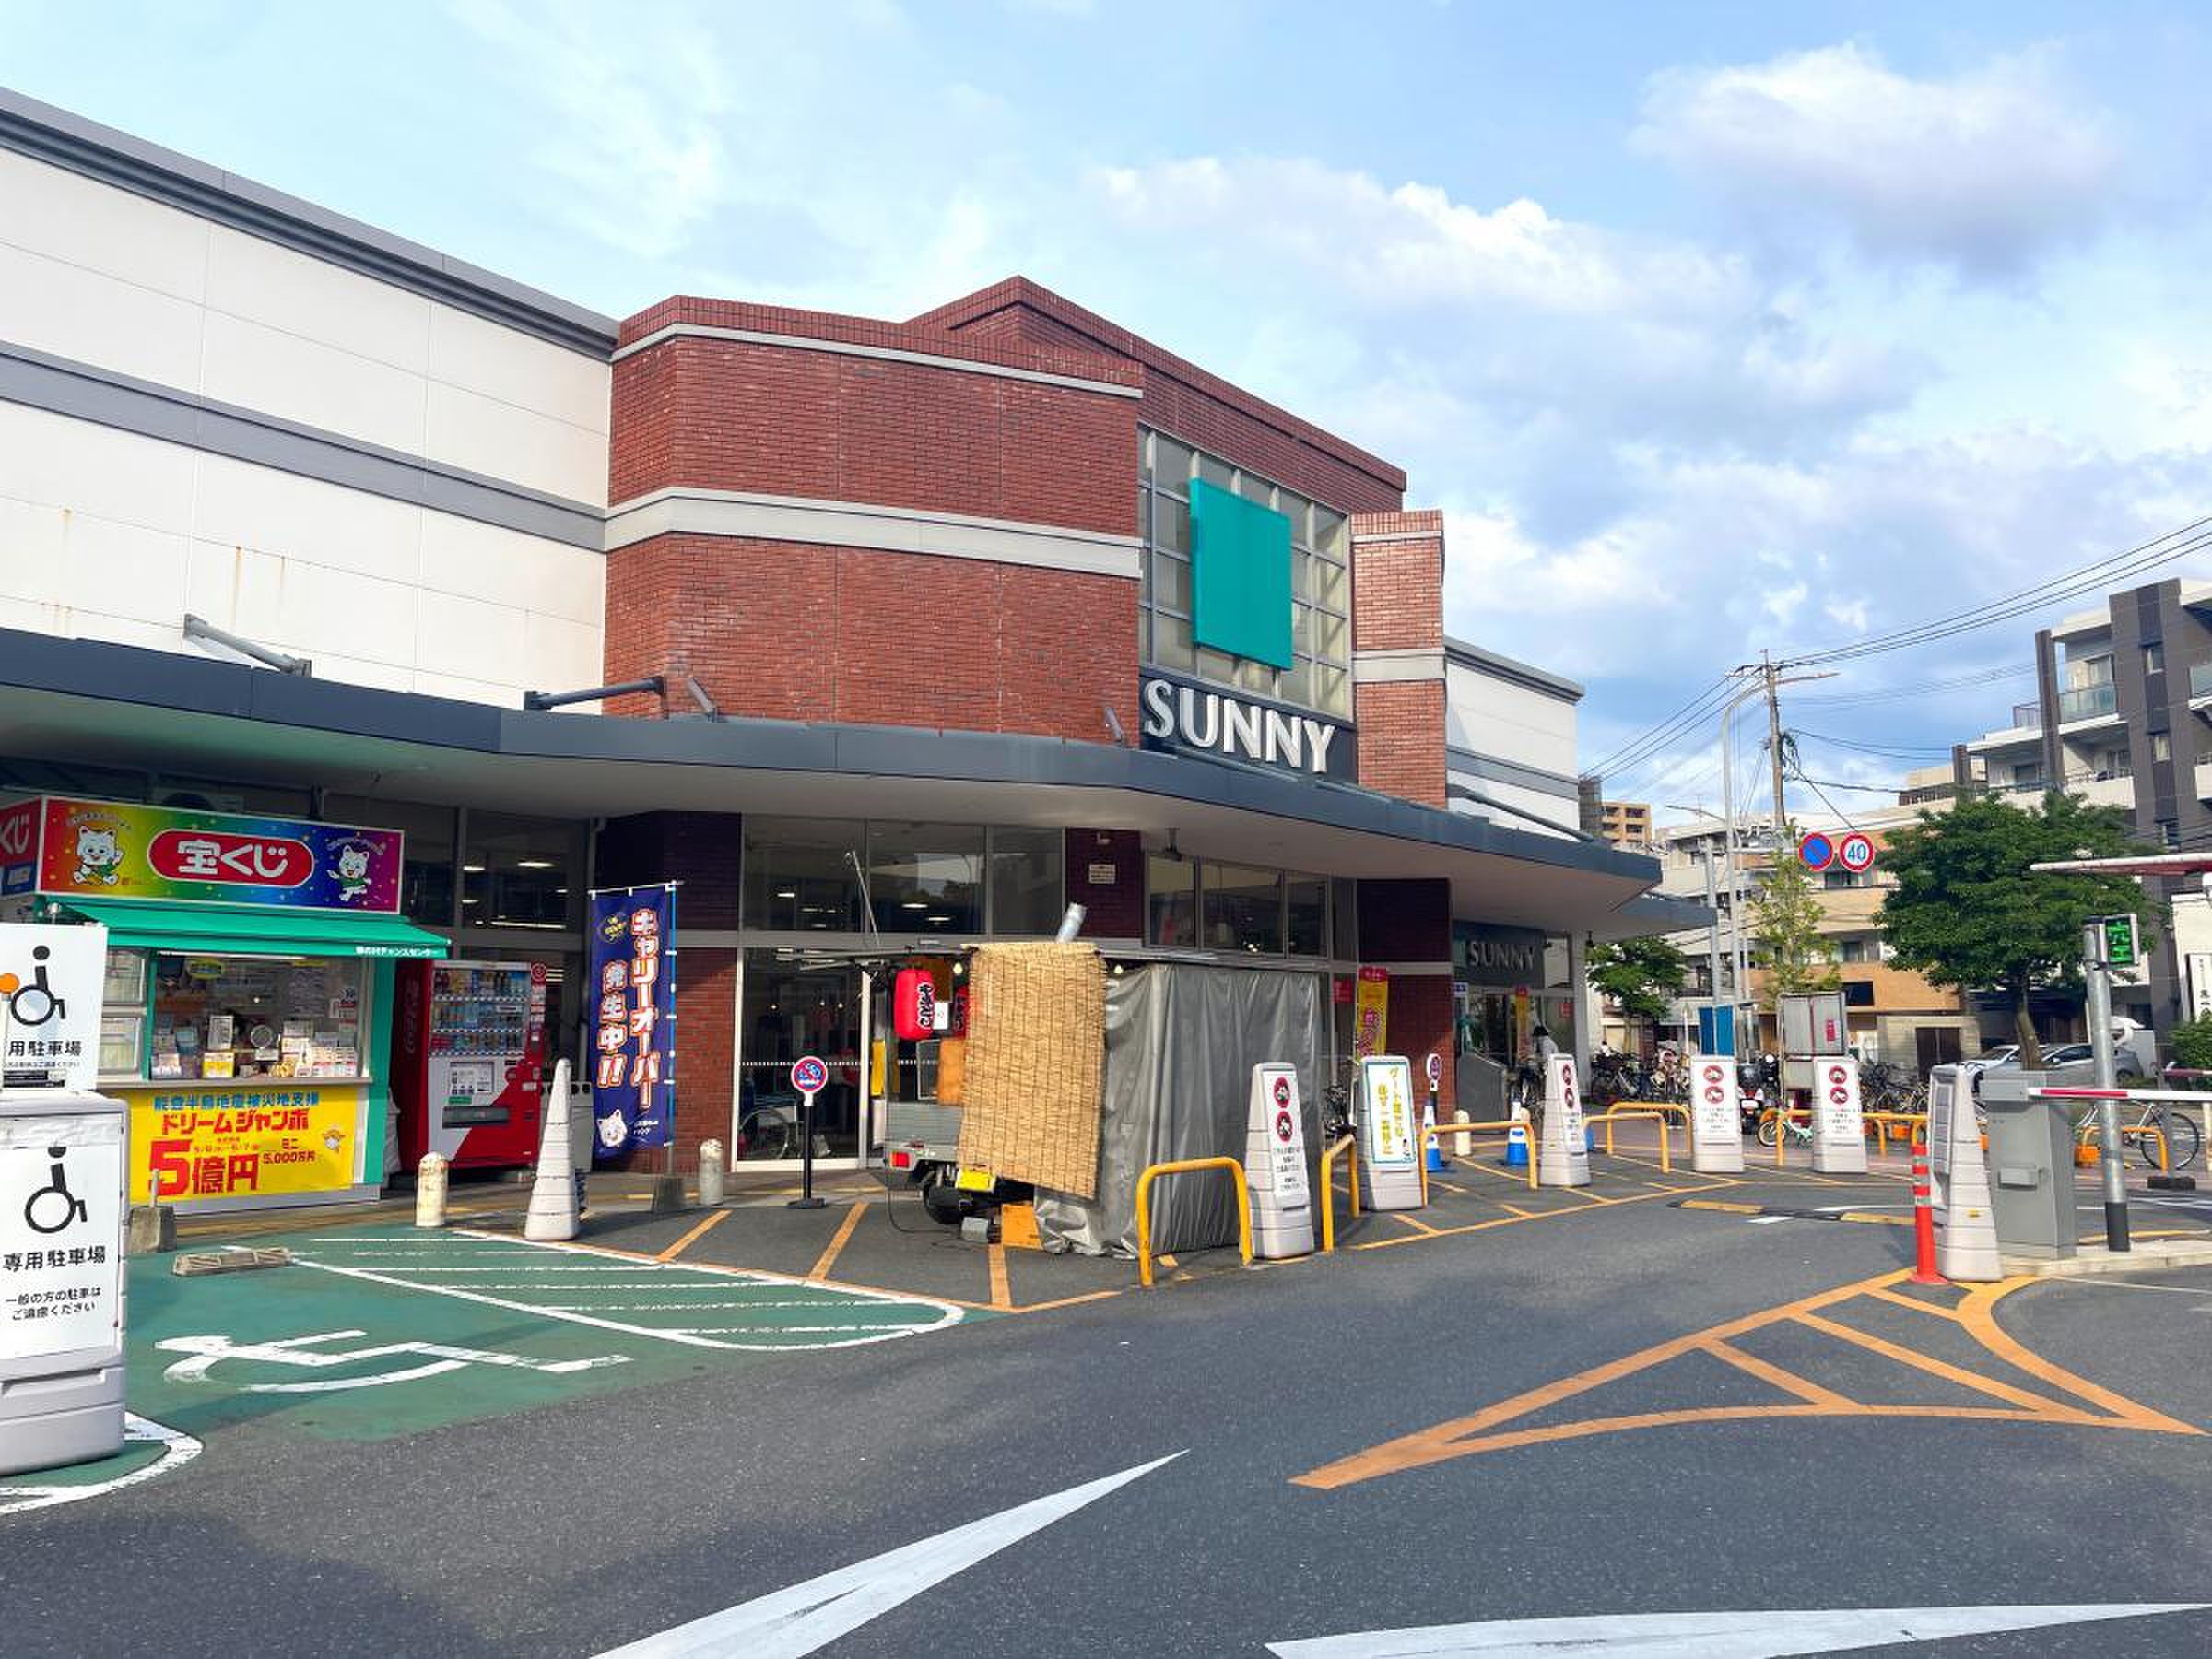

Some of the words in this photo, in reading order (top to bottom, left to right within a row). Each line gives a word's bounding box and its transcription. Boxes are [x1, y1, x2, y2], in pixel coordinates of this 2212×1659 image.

[1144, 678, 1335, 774] SUNNY
[177, 839, 288, 878] 宝くじ
[1847, 842, 1867, 862] 40
[1470, 940, 1535, 971] SUNNY
[630, 908, 660, 1111] キャリーオーバー
[161, 1108, 310, 1136] ドリームジャンボ
[148, 1138, 259, 1196] 5億円
[3, 1245, 105, 1273] 専用駐車場
[5, 1287, 101, 1305] 一般の方の駐車は
[12, 1301, 95, 1321] ご遠慮ください
